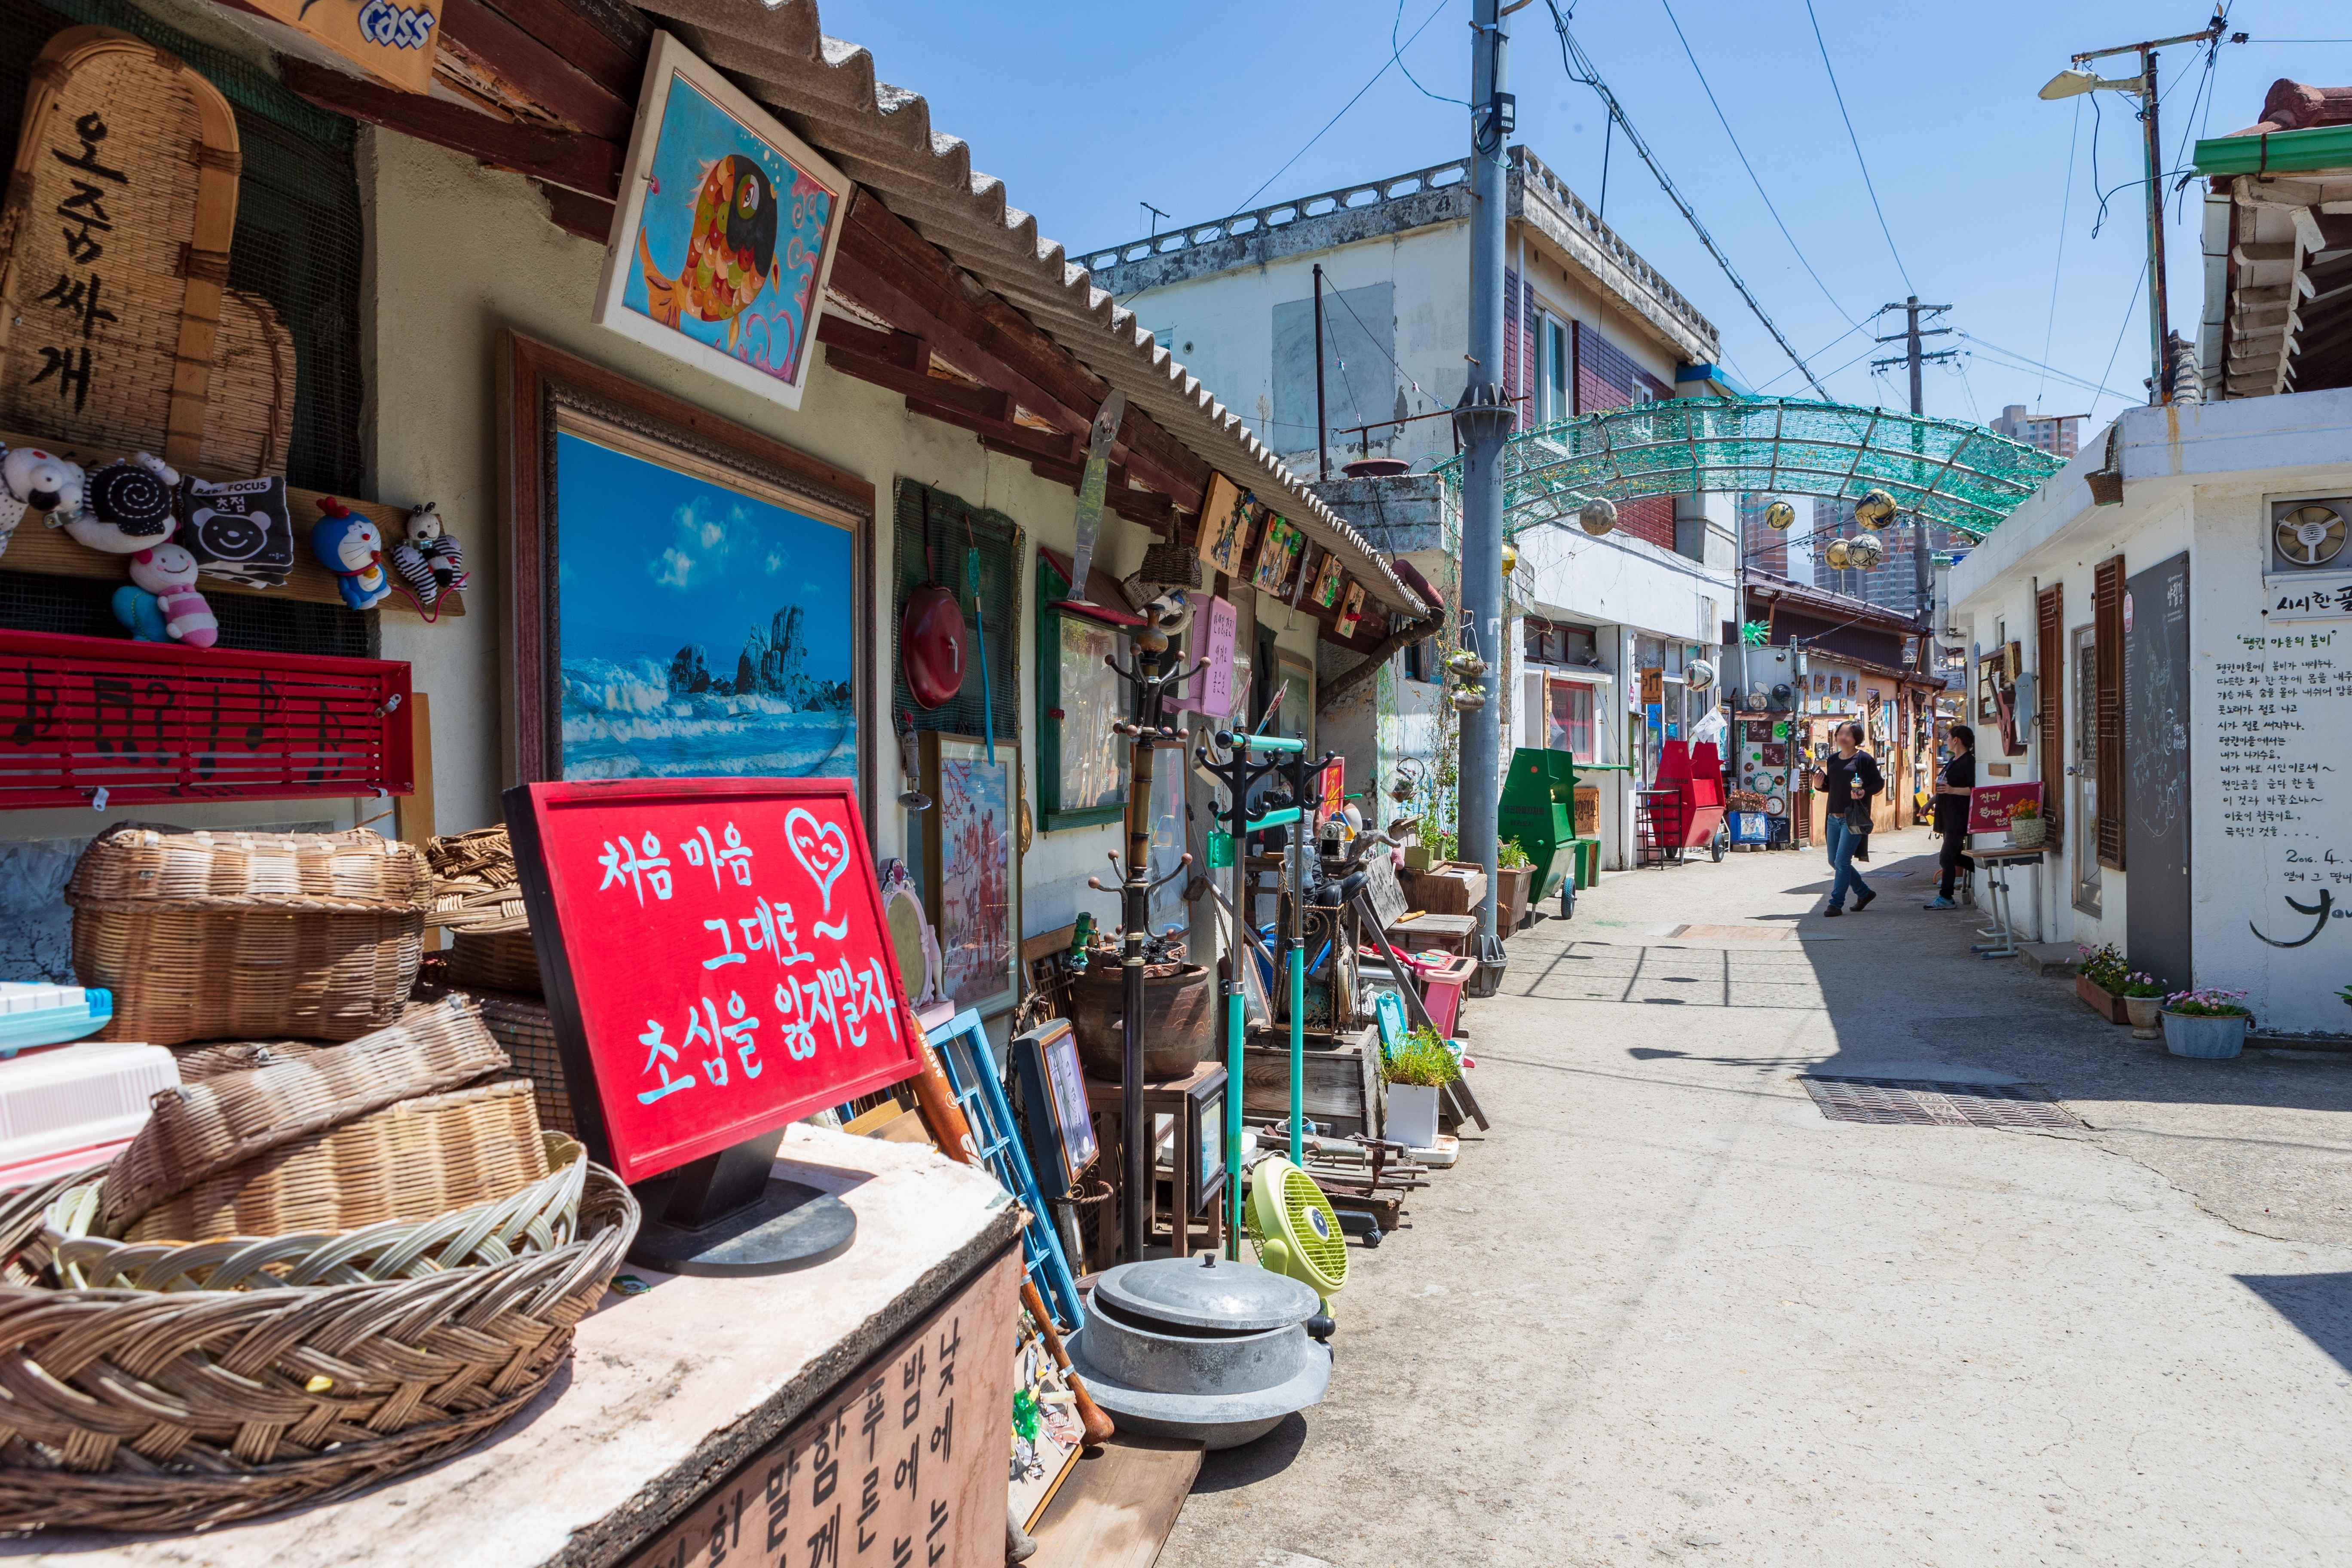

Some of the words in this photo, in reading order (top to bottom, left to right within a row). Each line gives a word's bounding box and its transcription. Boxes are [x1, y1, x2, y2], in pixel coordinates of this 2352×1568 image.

[358, 0, 435, 49] Cass
[28, 111, 129, 414] 오줌싸개
[228, 481, 267, 492] FOCUS
[216, 496, 245, 512] 초점
[1129, 581, 1145, 602] GARDEN
[2277, 591, 2332, 612] 시시한
[2272, 661, 2297, 671] 봄비가
[2249, 676, 2260, 685] 차
[2265, 676, 2275, 686] 한
[2308, 672, 2327, 684] 몸을
[2217, 690, 2234, 700] 가슴
[2259, 688, 2275, 698] 숨을
[2279, 687, 2297, 698] 몰아
[2302, 686, 2332, 697] 내쉬어
[2258, 704, 2276, 715] 절로
[2281, 704, 2297, 714] 나고
[2217, 721, 2238, 731] 시가
[2242, 721, 2260, 731] 절로
[2220, 751, 2240, 760] 내가
[2220, 765, 2240, 773] 내가
[2245, 765, 2263, 773] 바로
[2221, 779, 2258, 791] 천만금을
[2267, 778, 2286, 789] 준다
[2224, 811, 2251, 821] 이곳이
[2225, 826, 2254, 837] 극락인
[2286, 849, 2317, 863] 2016.
[598, 830, 673, 908] 처음
[679, 821, 754, 893] 마음
[2311, 873, 2323, 882] 그
[637, 990, 763, 1105] 초심을
[919, 1032, 944, 1078] MASTER
